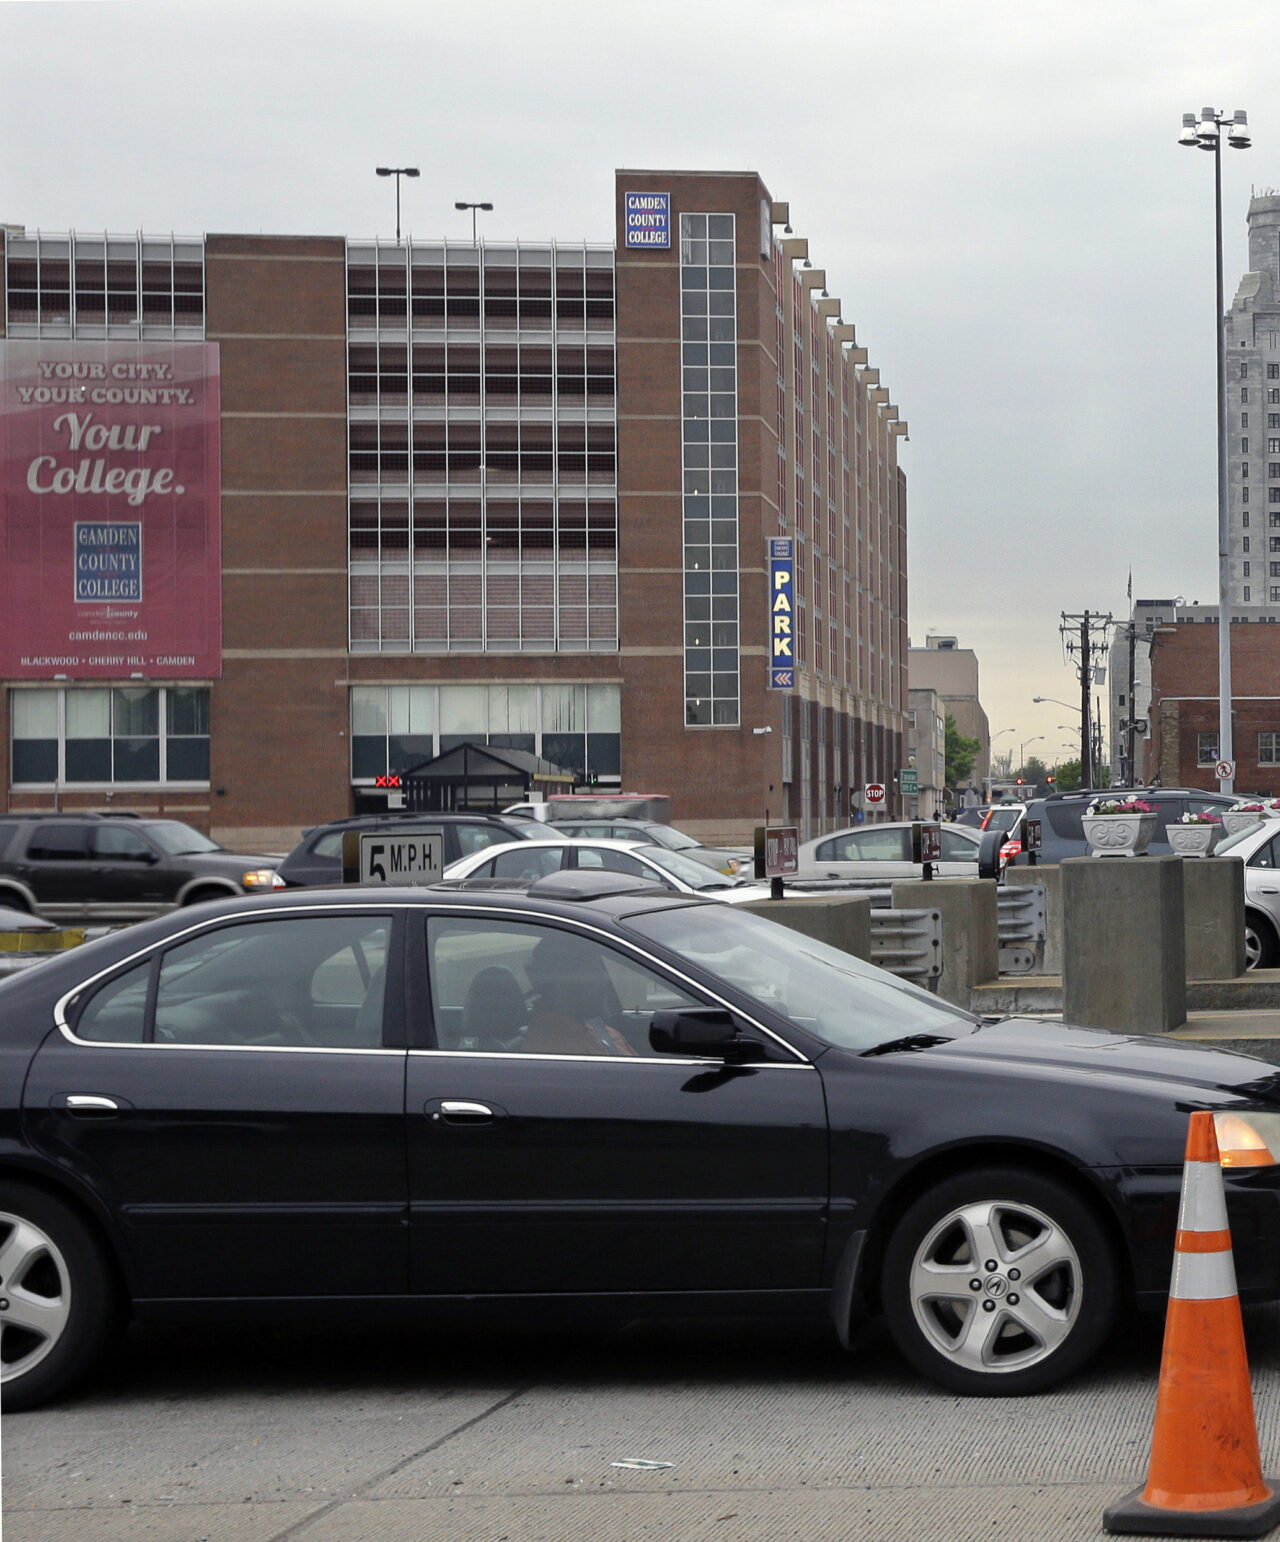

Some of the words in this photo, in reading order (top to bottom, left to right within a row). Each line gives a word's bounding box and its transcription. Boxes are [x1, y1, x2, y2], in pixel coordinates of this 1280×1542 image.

[628, 196, 666, 209] CAMDEN
[628, 214, 667, 226] COUNTY
[628, 230, 667, 244] COLLEGE
[39, 362, 106, 378] YOUR
[112, 363, 173, 380] CITY.
[18, 386, 86, 403] YOUR
[91, 388, 195, 404] COUNTY.
[53, 412, 162, 451] Your
[26, 456, 185, 506] College.
[79, 528, 137, 546] CAMDEN
[78, 553, 137, 571] COUNTY
[78, 579, 138, 597] COLLEGE
[110, 610, 138, 618] county
[772, 571, 792, 656] PARK
[69, 630, 148, 640] camdencc.edu
[20, 656, 79, 666] BLACKWOOD
[88, 656, 124, 666] CHERRY
[127, 656, 146, 666] HILL
[156, 656, 196, 666] CAMDEN
[866, 790, 884, 798] STOP
[370, 845, 386, 882] 5
[390, 843, 437, 872] M.P.H.
